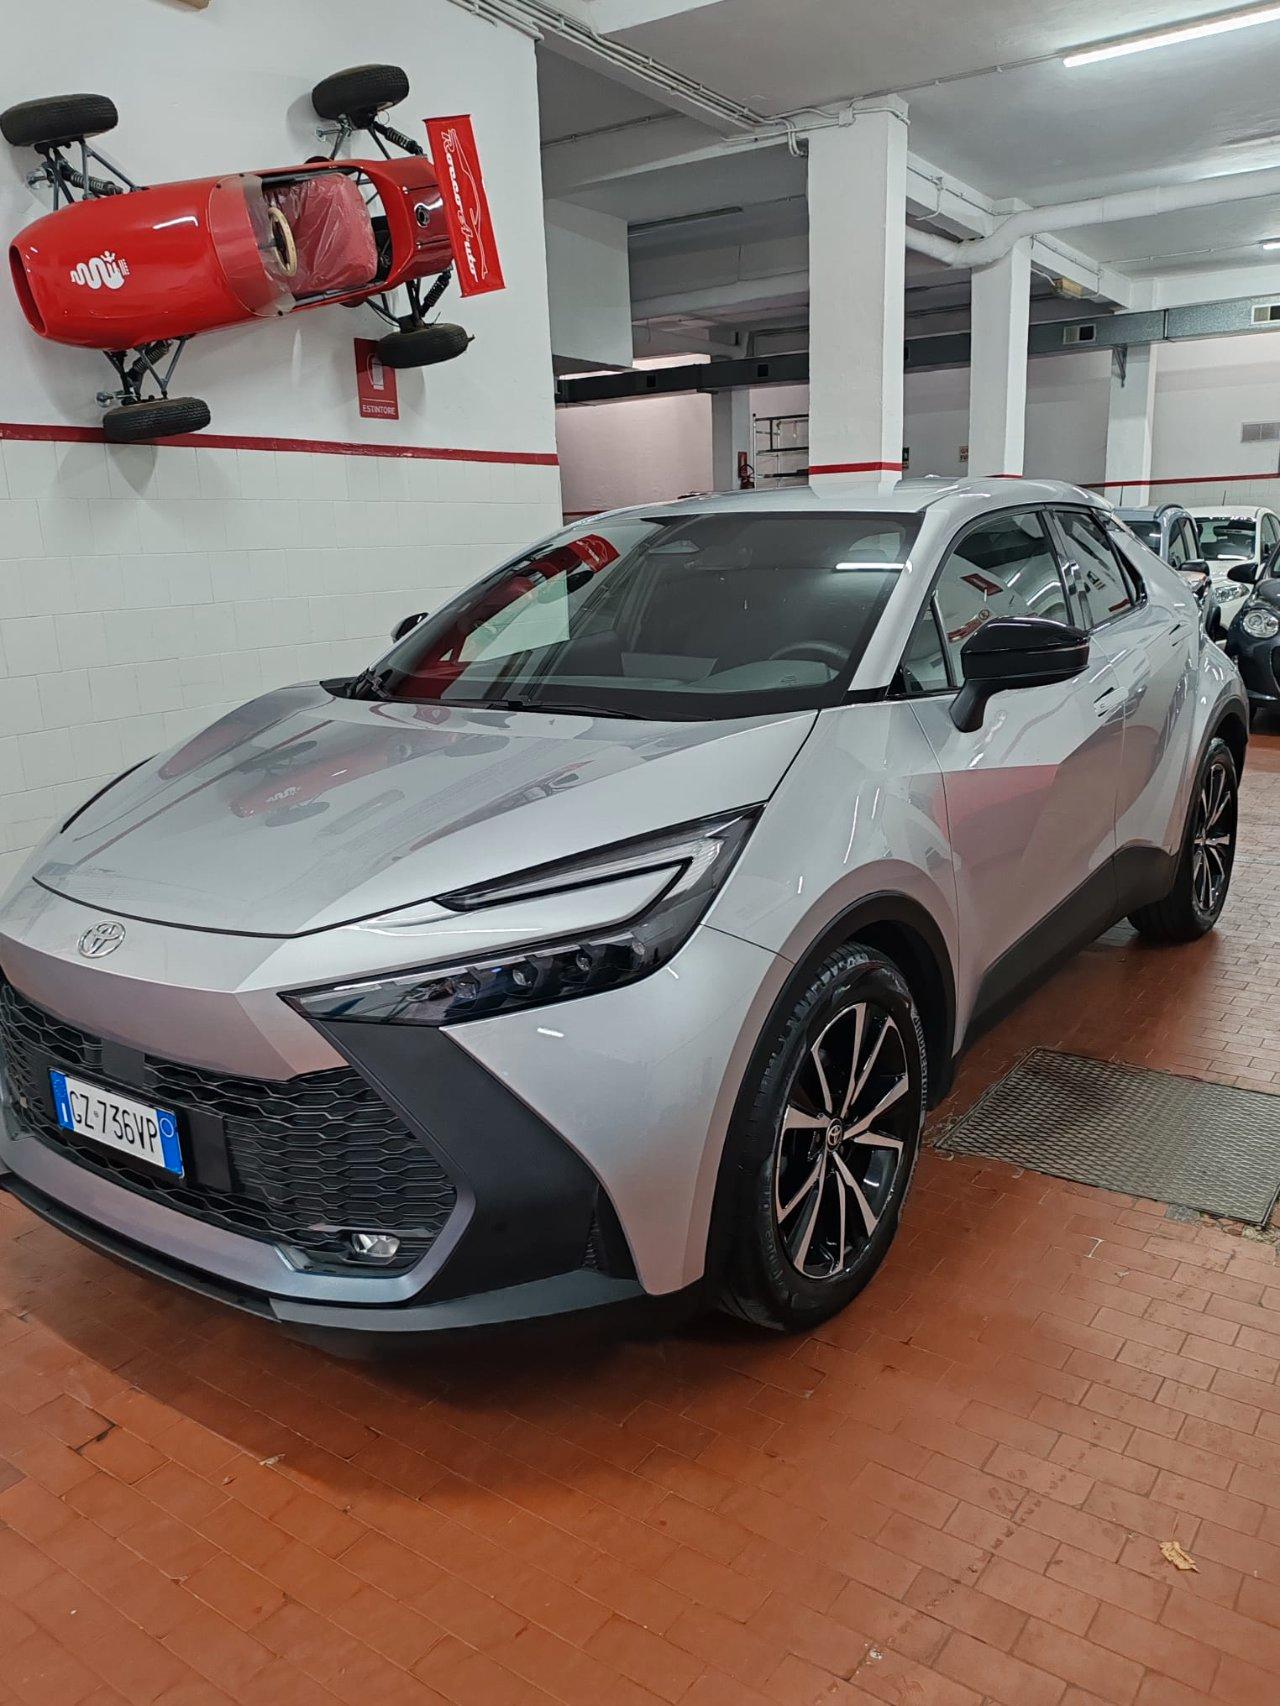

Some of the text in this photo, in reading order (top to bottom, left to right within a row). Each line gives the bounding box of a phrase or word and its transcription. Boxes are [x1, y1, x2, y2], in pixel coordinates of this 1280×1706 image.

[440, 130, 478, 283] Rocco Auto
[362, 405, 396, 415] ESTINTORE
